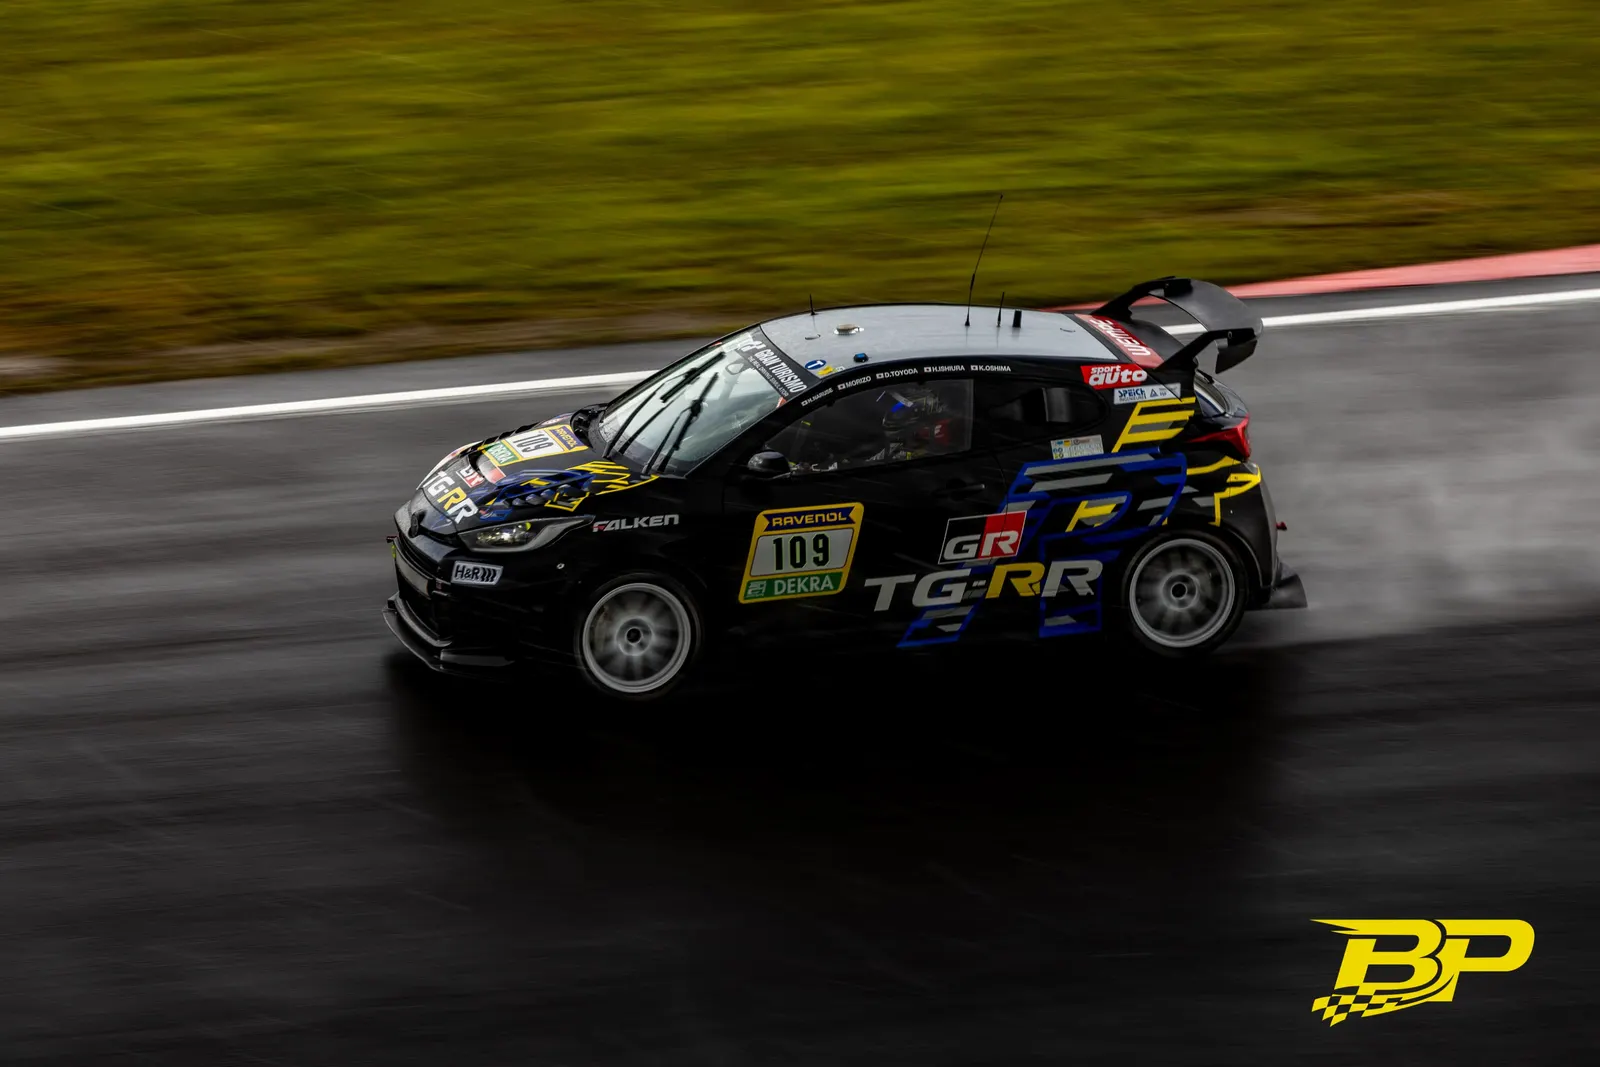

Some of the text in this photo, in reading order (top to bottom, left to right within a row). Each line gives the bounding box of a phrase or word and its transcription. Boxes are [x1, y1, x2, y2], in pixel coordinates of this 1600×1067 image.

[754, 348, 808, 393] GRAN TURISMO
[884, 368, 919, 380] D.TOYODA
[931, 364, 966, 373] H.ISHIURA
[978, 364, 1011, 373] K.OSHIMA
[1088, 368, 1148, 387] auto
[1090, 365, 1122, 376] sport
[845, 375, 872, 389] MORIZO
[514, 433, 553, 453] 109
[592, 513, 680, 533] FALKEN
[771, 510, 847, 528] RAVENOL
[772, 533, 830, 571] 109
[943, 530, 1020, 560] GR
[455, 564, 481, 580] H&R
[773, 574, 834, 596] DEKRA
